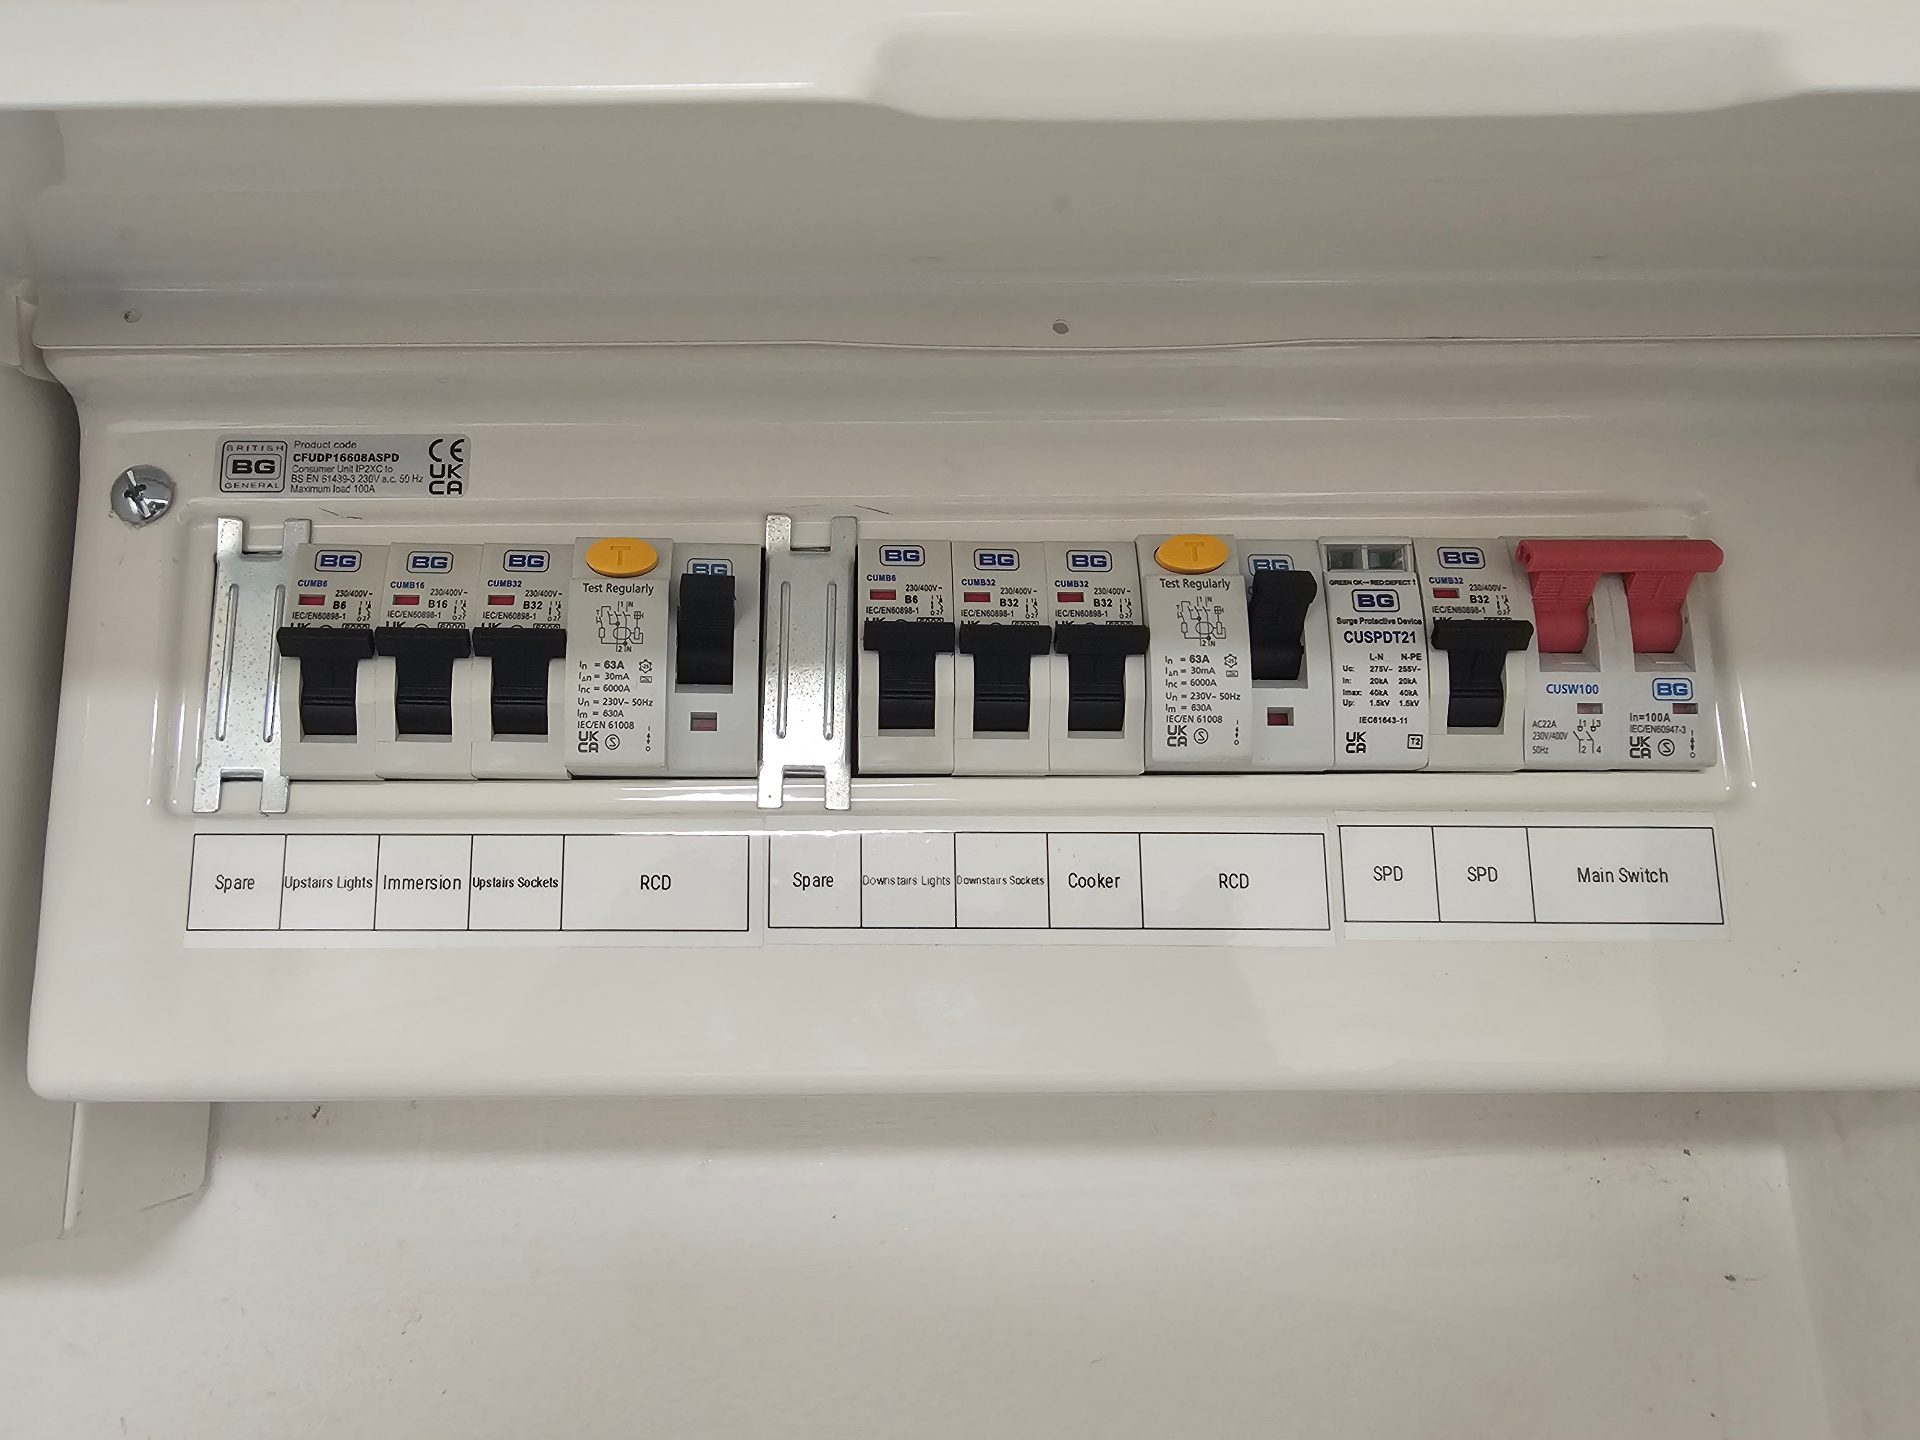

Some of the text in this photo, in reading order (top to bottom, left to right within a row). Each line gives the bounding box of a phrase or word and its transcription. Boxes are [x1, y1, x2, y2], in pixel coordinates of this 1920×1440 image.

[226, 444, 284, 452] BRITISH
[294, 440, 357, 449] Product code
[428, 438, 465, 462] CE
[293, 453, 400, 462] CFUDP16608ASPD
[232, 459, 275, 474] BG
[291, 464, 394, 473] Consumer Unit IP2XC to
[429, 464, 464, 479] UK
[291, 474, 304, 483] BS
[306, 474, 319, 483] EN
[357, 474, 380, 483] 230V
[411, 474, 424, 483] Hz
[290, 484, 376, 493] Maximum load 100A
[428, 480, 463, 495] CA
[610, 545, 631, 566] T
[885, 550, 920, 562] BG
[1184, 541, 1205, 562] T
[320, 554, 357, 568] BG
[412, 556, 448, 569] BG
[508, 554, 545, 568] BG
[979, 553, 1015, 566] BG
[1072, 554, 1107, 567] BG
[1443, 551, 1480, 565] BG
[297, 579, 328, 587] CUMB6
[390, 581, 425, 589] CUMB16
[487, 579, 522, 587] CUMB32
[961, 578, 996, 586] CUMB32
[1054, 580, 1089, 588] CUMB32
[1159, 578, 1231, 591] Test Regularly
[583, 582, 655, 595] Test Regularly
[428, 599, 448, 608] B16
[904, 594, 919, 604] B6
[999, 598, 1019, 607] B32
[1093, 598, 1113, 607] B32
[1357, 594, 1395, 608] BG
[1469, 594, 1490, 603] B32
[332, 600, 347, 610] B6
[523, 600, 543, 610] B32
[1336, 616, 1358, 626] Surge
[1359, 616, 1396, 625] Protective
[1397, 617, 1423, 625] Device
[1344, 630, 1416, 644] CUSPDT21
[1189, 654, 1210, 664] 63A
[1369, 653, 1422, 661] L-N N-PE
[603, 660, 625, 669] 63A
[604, 672, 630, 680] 30mA
[1190, 666, 1216, 675] 30mA
[1190, 678, 1217, 687] 6000A
[1369, 677, 1389, 685] 20kA
[1398, 677, 1418, 685] 20kA
[602, 684, 631, 693] 6000A
[1369, 689, 1389, 697] 40kA
[1399, 689, 1419, 697] 40kA
[1546, 683, 1599, 694] CUSW100
[1656, 683, 1689, 696] BG
[1219, 692, 1241, 701] 50Hz
[632, 698, 654, 707] 50Hz
[1190, 703, 1213, 712] 630A
[1369, 699, 1390, 707] 1.5kV
[1399, 699, 1420, 707] 1.5kV
[602, 709, 624, 718] 630A
[1629, 712, 1671, 722] In=100A
[577, 720, 635, 730] IEC/EN 61008
[1165, 715, 1223, 724] IEC/EN 61008
[1359, 716, 1408, 724] IEC61643-11
[1532, 719, 1557, 728] AC22A
[1167, 725, 1187, 736] UK
[578, 731, 599, 742] UK
[1166, 736, 1188, 747] CA
[1346, 731, 1367, 743] UK
[1410, 737, 1421, 745] T2
[1629, 736, 1651, 747] UK
[577, 742, 599, 753] CA
[1345, 743, 1366, 754] CA
[1629, 747, 1652, 759] CA
[1373, 866, 1404, 881] SPD
[1467, 866, 1499, 883] SPD
[1577, 867, 1669, 883] Main Switch
[215, 874, 255, 893] Spare
[284, 876, 373, 891] Upstairs Lights
[383, 874, 462, 890] Immersion
[472, 876, 559, 890] Upstairs Sockets
[640, 875, 672, 891] RCD
[792, 872, 834, 890] Spare
[862, 875, 951, 887] Downstairs Lights
[956, 875, 1045, 886] Downstairs Sockets
[1068, 872, 1121, 888] Cooker
[1218, 873, 1250, 889] RCD
